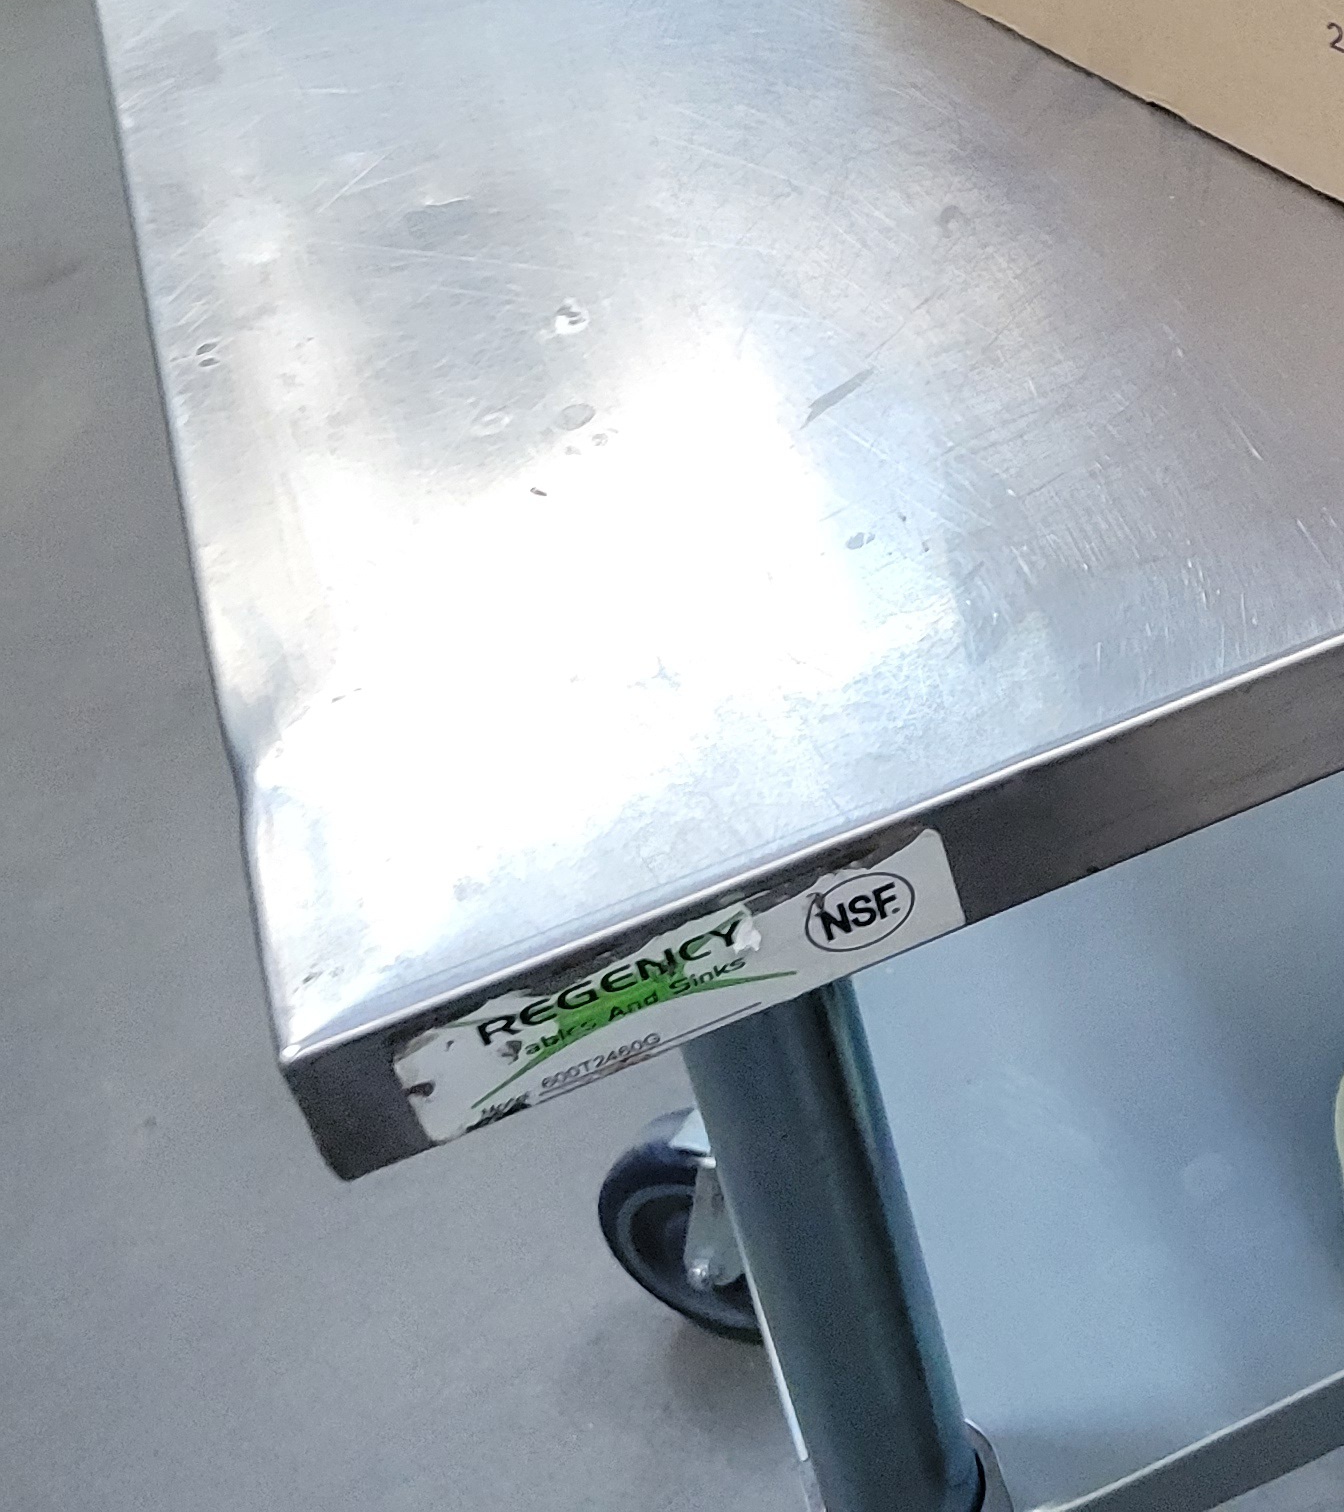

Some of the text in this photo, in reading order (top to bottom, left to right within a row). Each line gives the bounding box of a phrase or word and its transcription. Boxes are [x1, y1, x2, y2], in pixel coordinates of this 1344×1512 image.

[819, 881, 898, 942] NSF
[475, 918, 743, 1047] REGENCY
[606, 989, 660, 1023] And
[667, 955, 747, 996] Sinks
